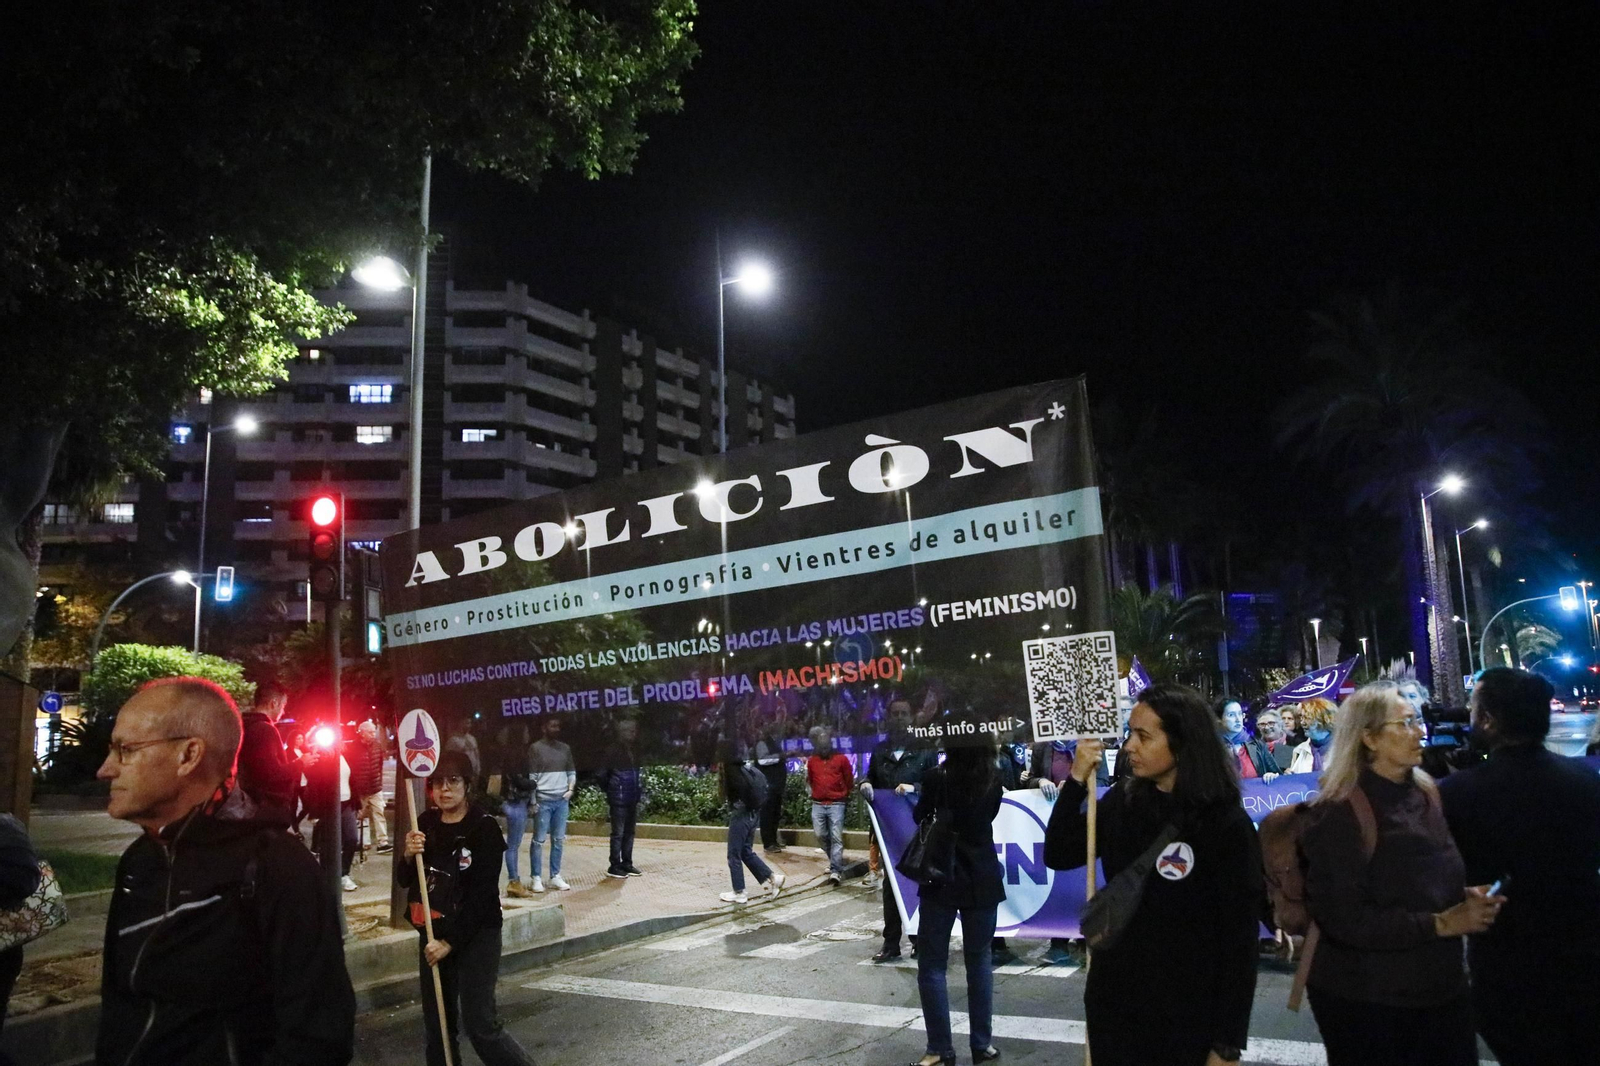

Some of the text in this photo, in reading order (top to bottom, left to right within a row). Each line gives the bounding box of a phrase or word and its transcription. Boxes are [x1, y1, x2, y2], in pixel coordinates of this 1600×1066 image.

[393, 508, 1076, 638] Género Prostitución Pornografía Vientres de alquiler
[437, 666, 485, 686] LUCHAS
[486, 660, 539, 680] CONTRA
[539, 653, 586, 674] TODAS
[588, 650, 617, 668] LAS
[619, 635, 722, 664] VIOLENCIAS
[725, 627, 785, 651] HACIA
[786, 621, 822, 643] LAS
[826, 607, 925, 638] MUJERES
[930, 585, 1078, 628] (FEMINISMO)
[501, 656, 903, 718] ERES PARTE DEL PROBLEMA (MACHISMO)
[946, 720, 975, 736] info
[979, 716, 1013, 737] aquí
